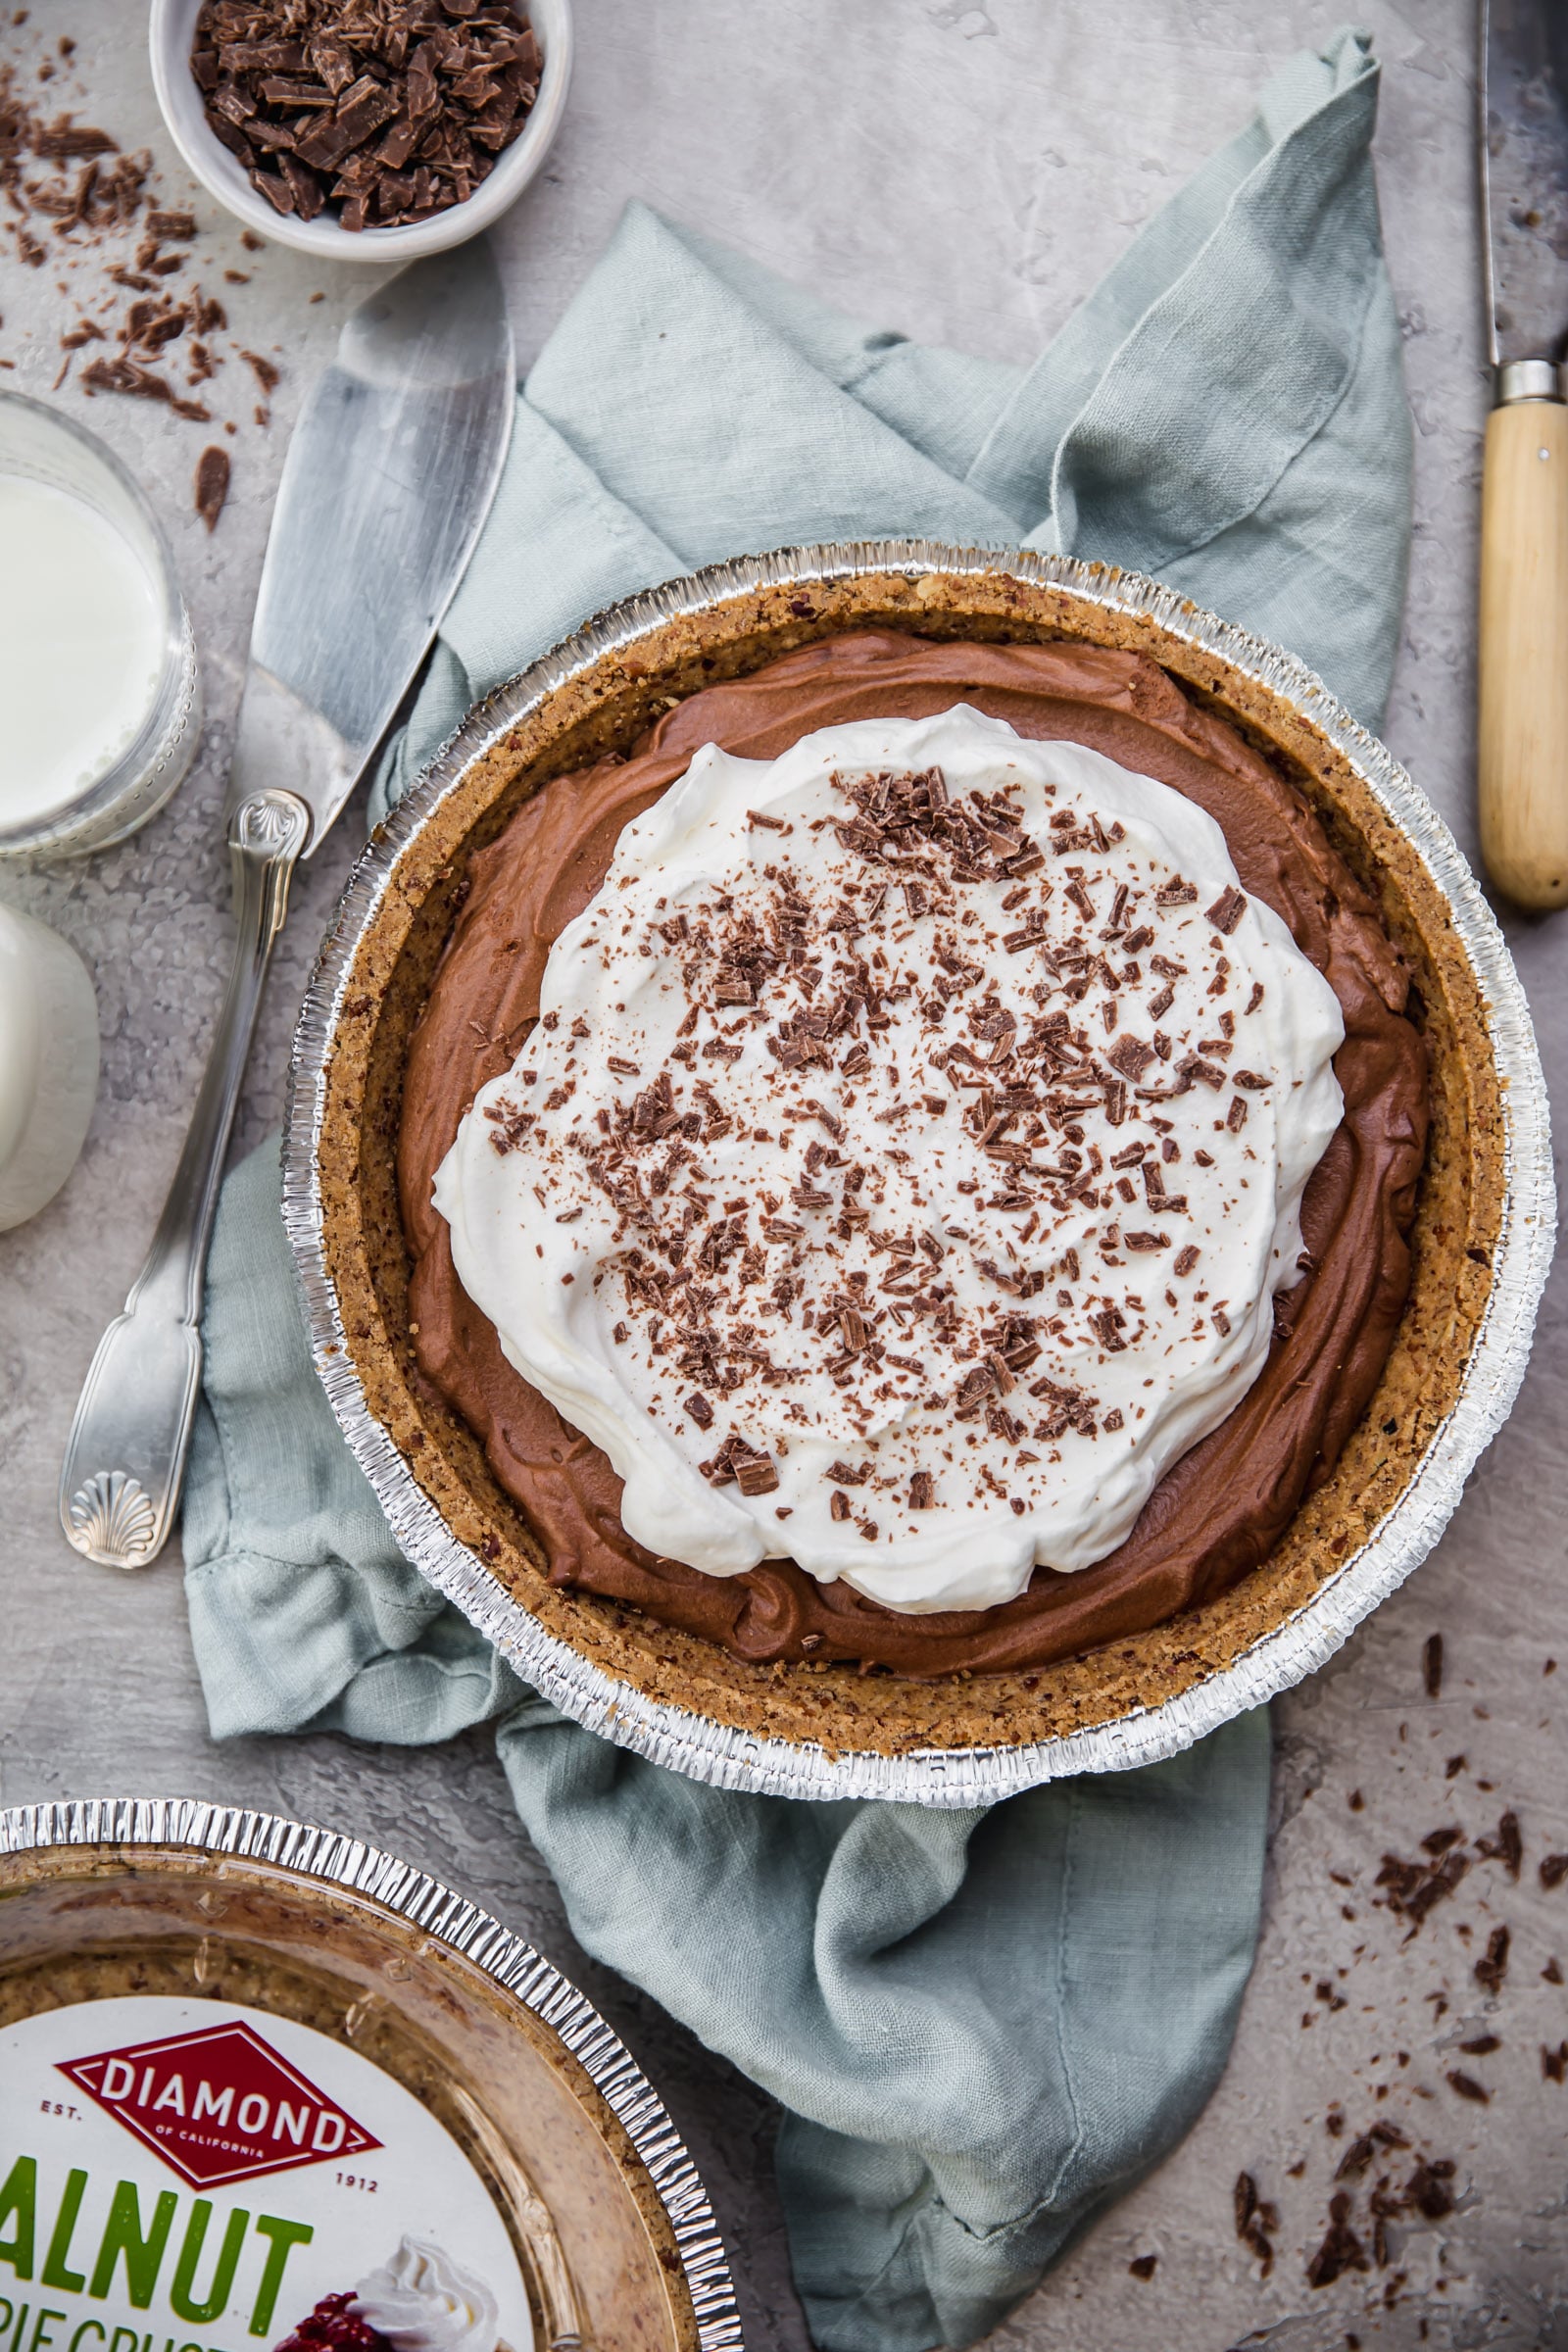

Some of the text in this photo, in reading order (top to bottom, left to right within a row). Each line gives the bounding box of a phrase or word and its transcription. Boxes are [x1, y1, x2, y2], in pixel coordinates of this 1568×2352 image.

[40, 2099, 82, 2122] EST.
[100, 2057, 347, 2153] DIAMOND
[155, 2124, 265, 2159] OF CALIFORNIA
[336, 2172, 378, 2193] 1912
